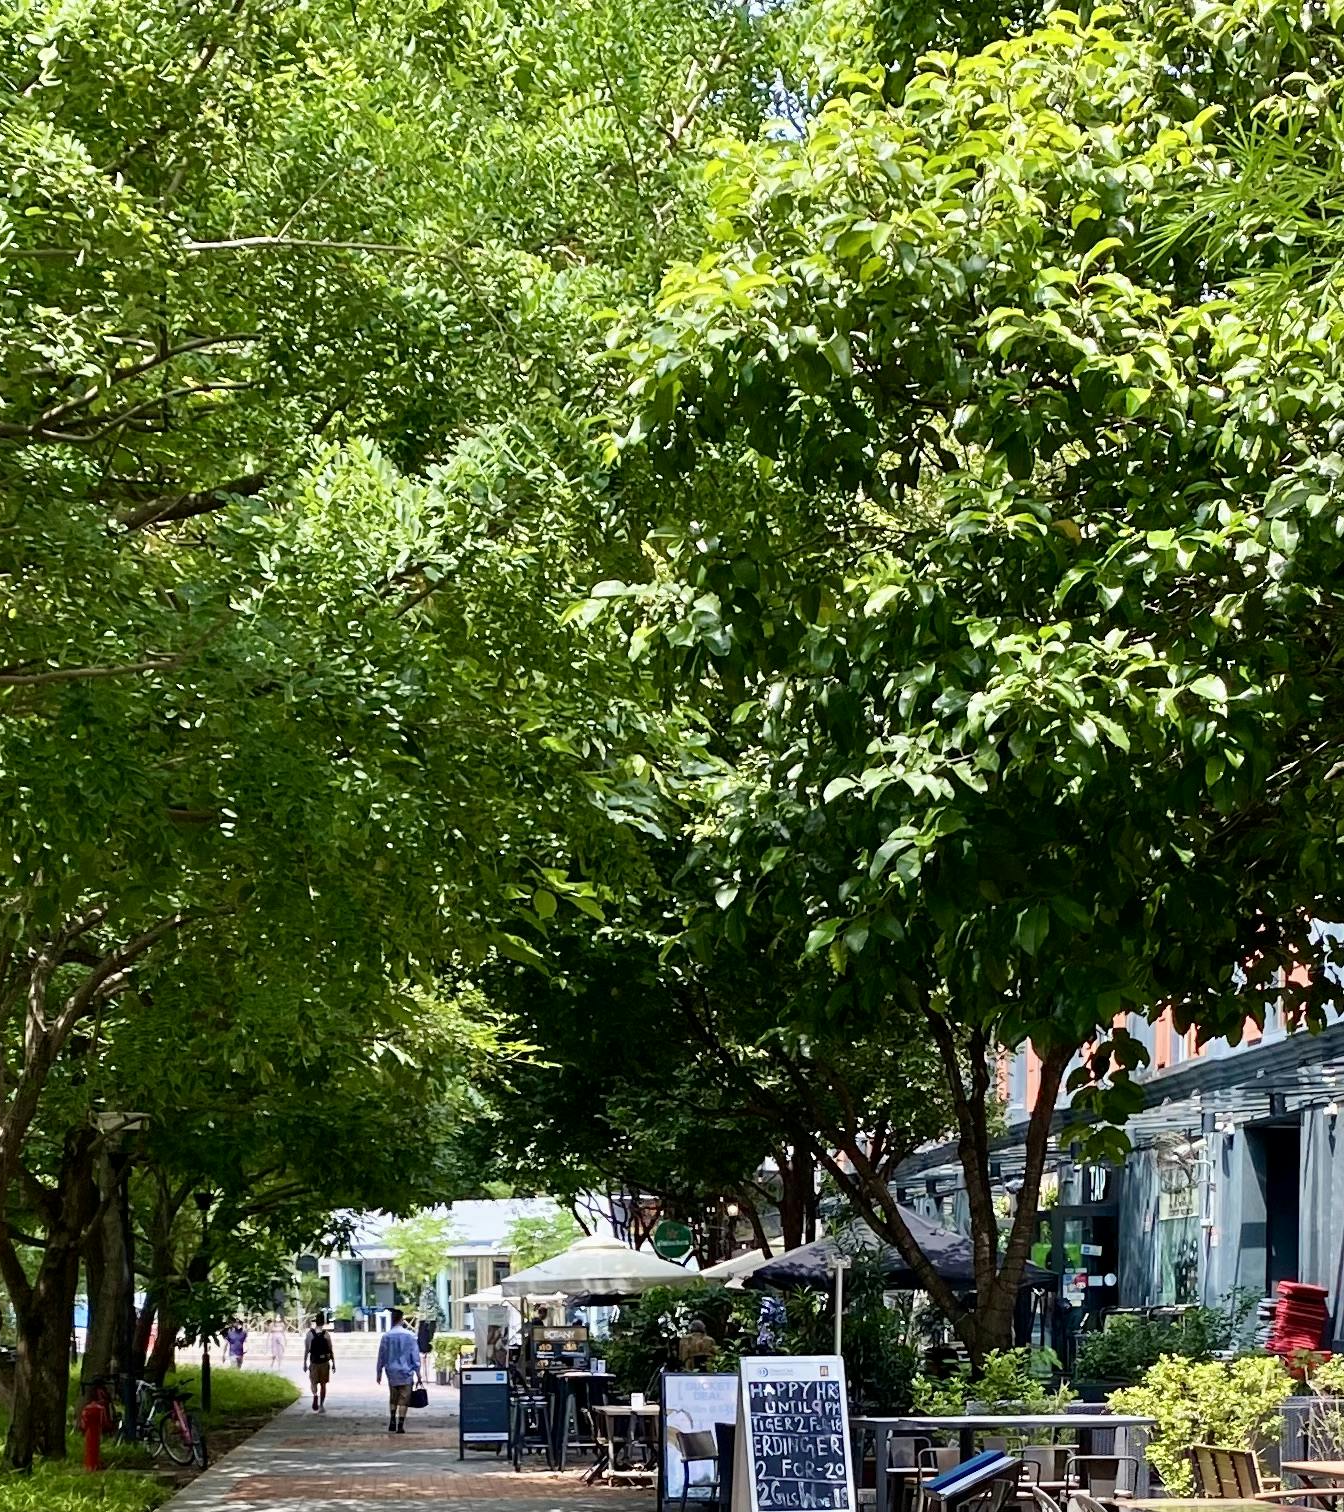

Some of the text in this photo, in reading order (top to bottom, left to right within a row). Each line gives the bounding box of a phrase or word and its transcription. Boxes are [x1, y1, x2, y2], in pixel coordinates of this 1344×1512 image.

[750, 1381, 812, 1399] HAPPY
[764, 1399, 812, 1414] UNTIL
[751, 1416, 793, 1432] TIGER
[794, 1416, 809, 1433] 2
[753, 1434, 844, 1459] ERDINGER
[755, 1460, 771, 1480] 2
[756, 1482, 773, 1507] 2
